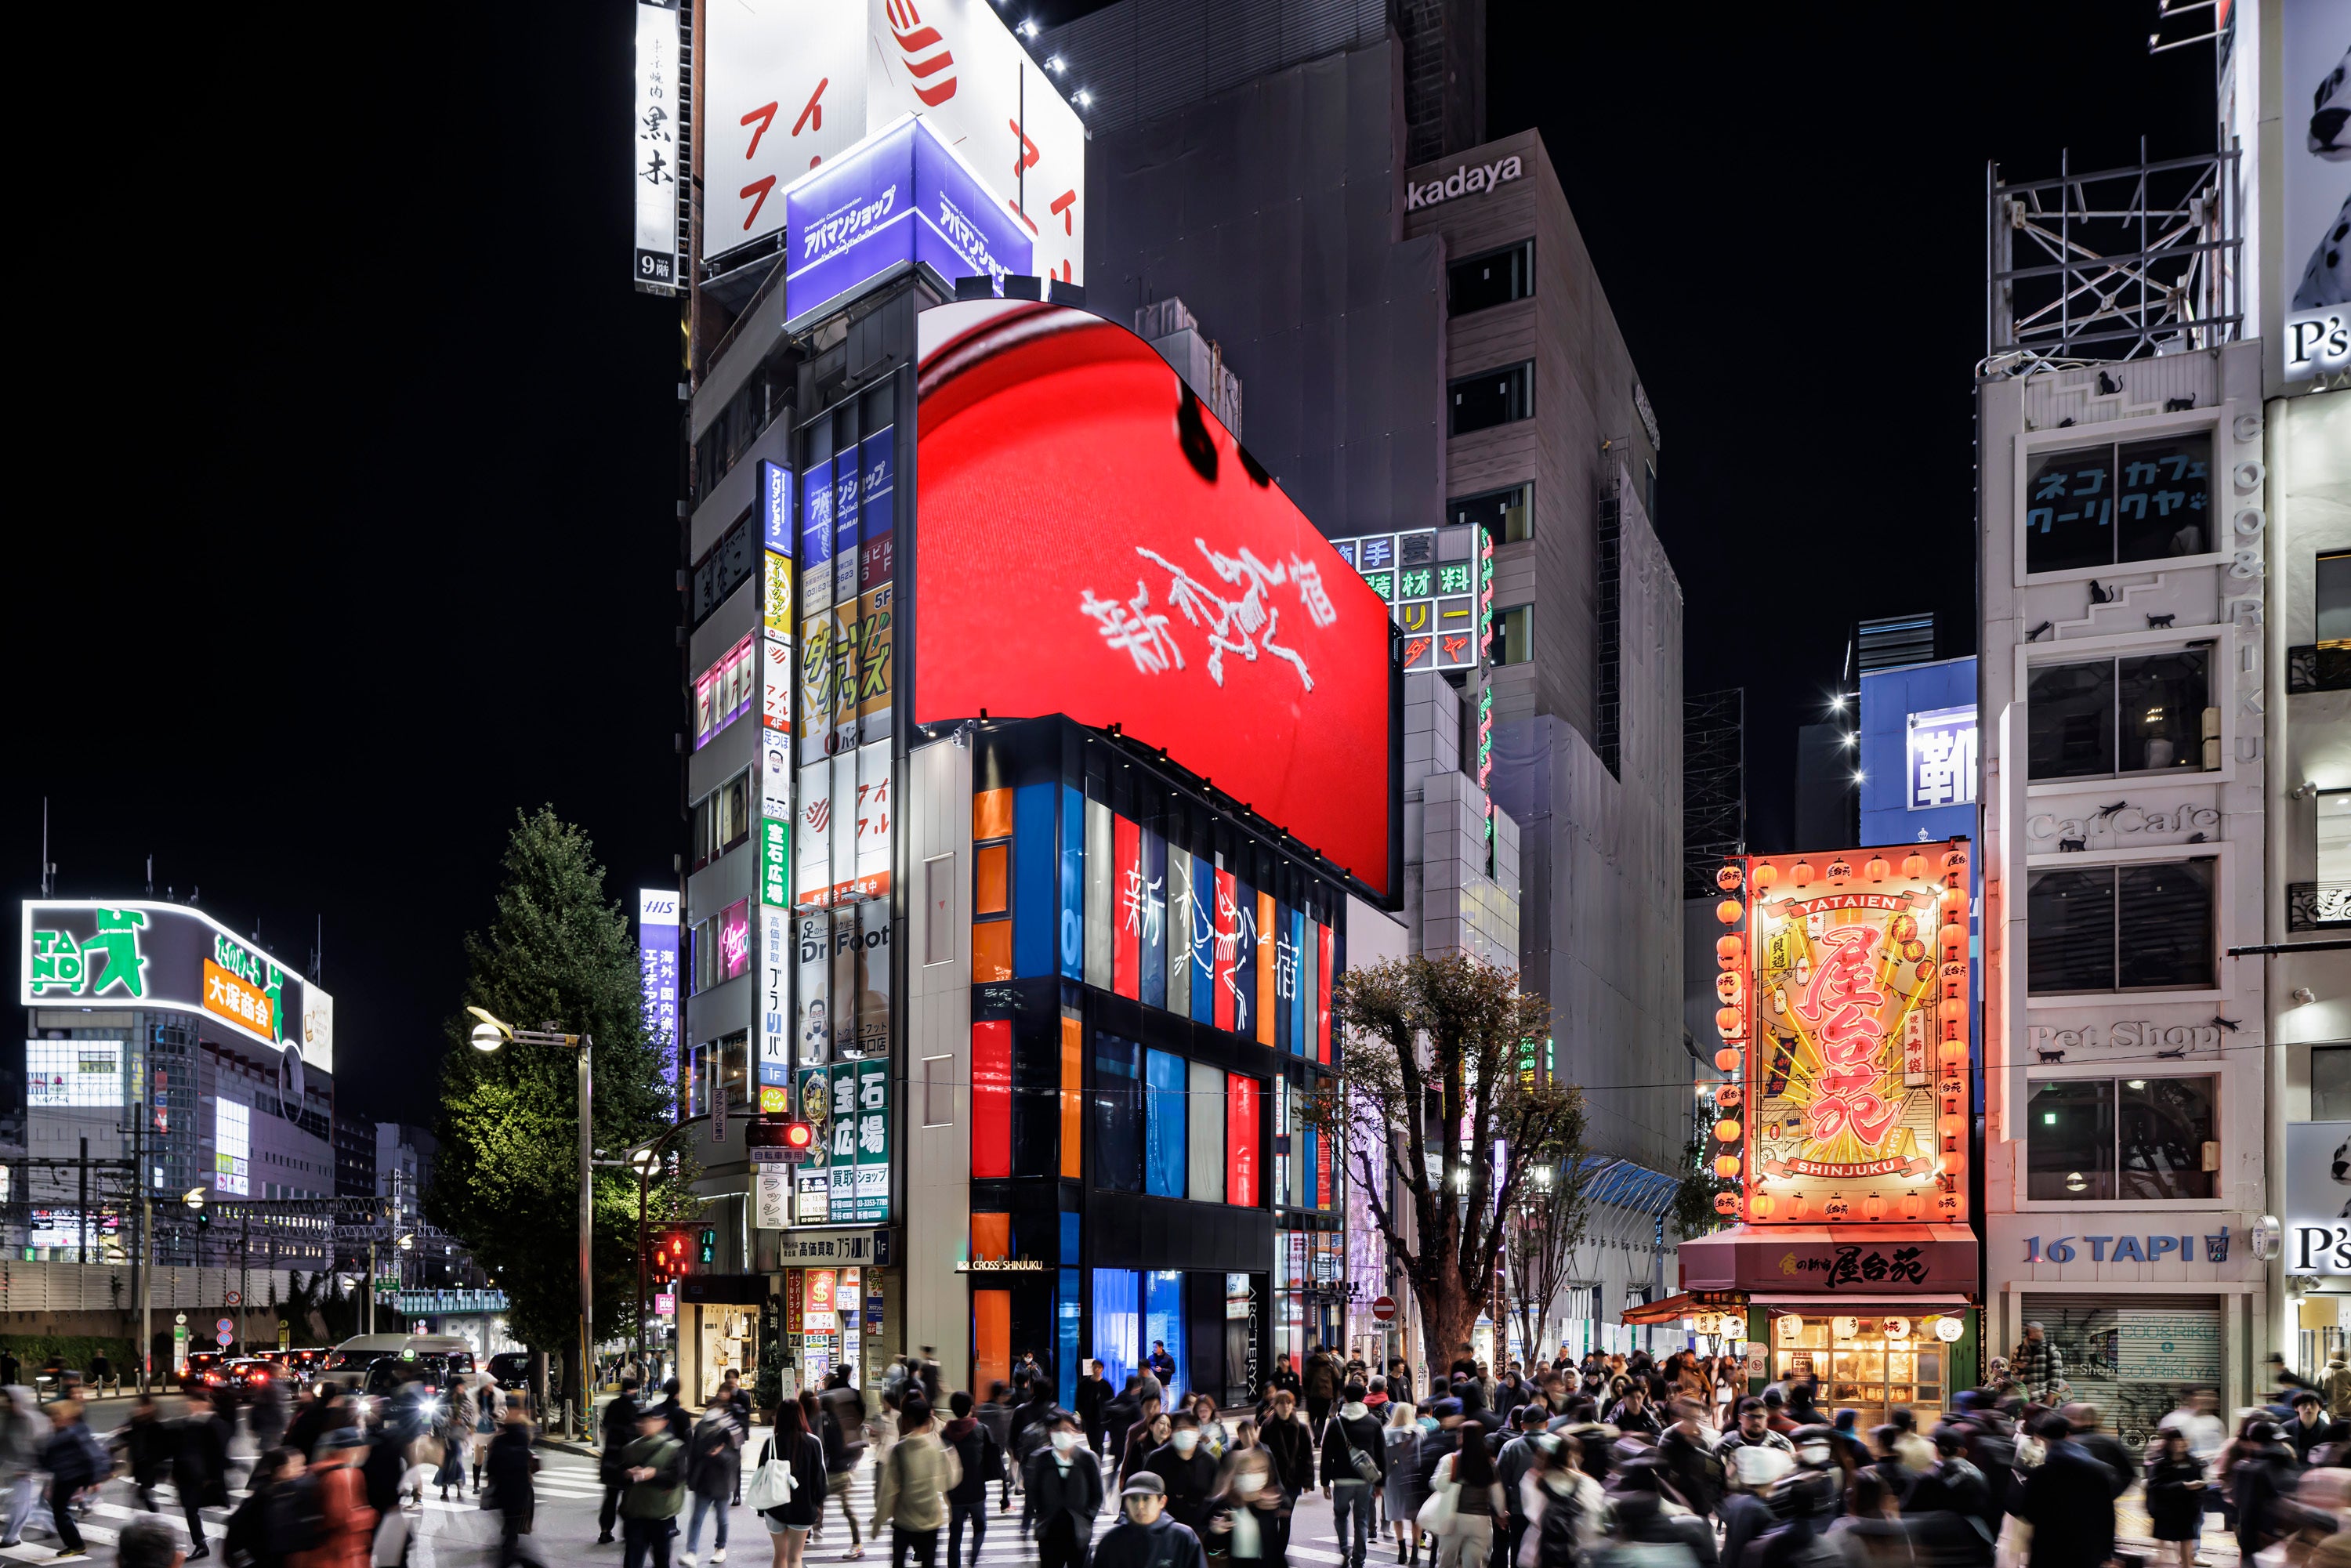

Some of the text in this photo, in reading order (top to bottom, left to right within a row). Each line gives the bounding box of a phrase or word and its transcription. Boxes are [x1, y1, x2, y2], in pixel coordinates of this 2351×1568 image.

[639, 105, 674, 185] 黒木
[1405, 155, 1522, 210] kadaya
[804, 196, 862, 234] Dramatic Communication
[804, 184, 897, 259] アパマンショップ
[641, 255, 669, 277] 9階
[2027, 491, 2185, 534] クーリクヤ
[875, 588, 892, 610] 5F
[804, 614, 877, 683] ダーツ
[770, 717, 783, 730] 4F
[2027, 803, 2219, 841] Cat Cafe
[766, 823, 784, 904] 宝石広場
[643, 900, 676, 914] HIS
[1800, 894, 1898, 915] YATAIEN
[770, 916, 780, 964] 高価買取
[802, 925, 889, 964] Dr Foot
[32, 957, 80, 980] NO
[208, 975, 269, 1028] 大塚商会
[1795, 923, 1900, 1147] 屋台苑
[2027, 1020, 2220, 1050] Pet Shop
[768, 1066, 781, 1082] 1F
[833, 1071, 886, 1114] 宝石
[714, 1090, 724, 1141] スクランブル交差点
[833, 1114, 886, 1156] 広場
[754, 1151, 803, 1161] 自転車専用
[1797, 1161, 1896, 1176] SHINJUKU
[799, 1241, 835, 1257] 高価買取
[877, 1240, 886, 1255] 1F
[2023, 1235, 2193, 1263] 16 TAPI
[973, 1260, 1043, 1270] CROSS SHINJUKU
[1824, 1245, 1930, 1289] 屋台苑
[1248, 1285, 1258, 1397] ARC'TERYX
[2120, 1325, 2218, 1340] COO&RIKU
[2080, 1363, 2116, 1377] Shop
[2117, 1365, 2219, 1378] COORIKUYA
